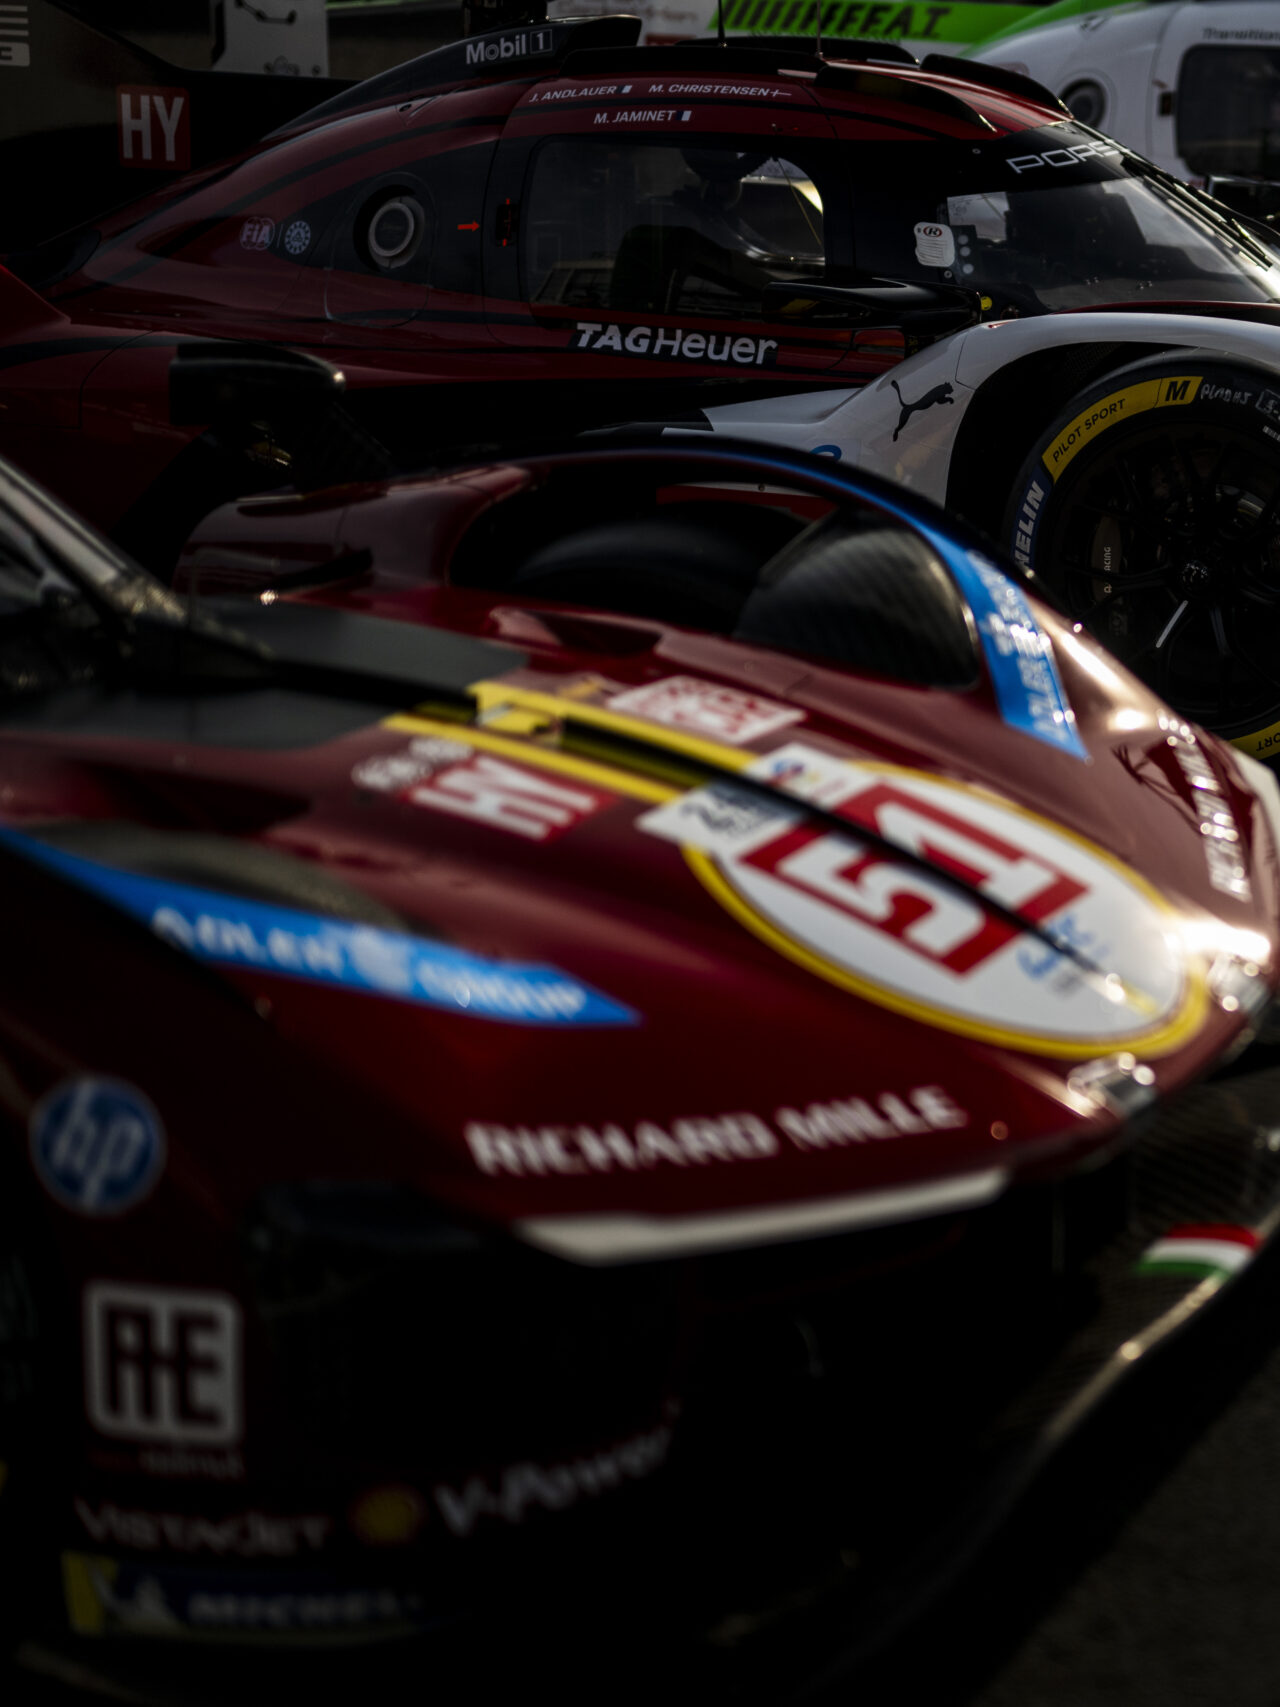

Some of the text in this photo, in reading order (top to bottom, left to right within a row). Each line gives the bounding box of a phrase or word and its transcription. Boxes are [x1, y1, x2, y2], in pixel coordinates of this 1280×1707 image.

[466, 34, 528, 65] Mobil
[529, 85, 618, 103] J. ANDLAUER
[649, 84, 770, 97] M. CHRISTENSEN
[120, 93, 185, 163] HY
[594, 110, 677, 125] M. JAMINET
[1006, 141, 1119, 174] PORS
[1165, 380, 1191, 401] M
[1052, 398, 1127, 463] PILOT SPORT
[1103, 546, 1112, 572] ACING
[772, 798, 1067, 958] 51
[464, 1086, 968, 1177] RICHARD MILLE
